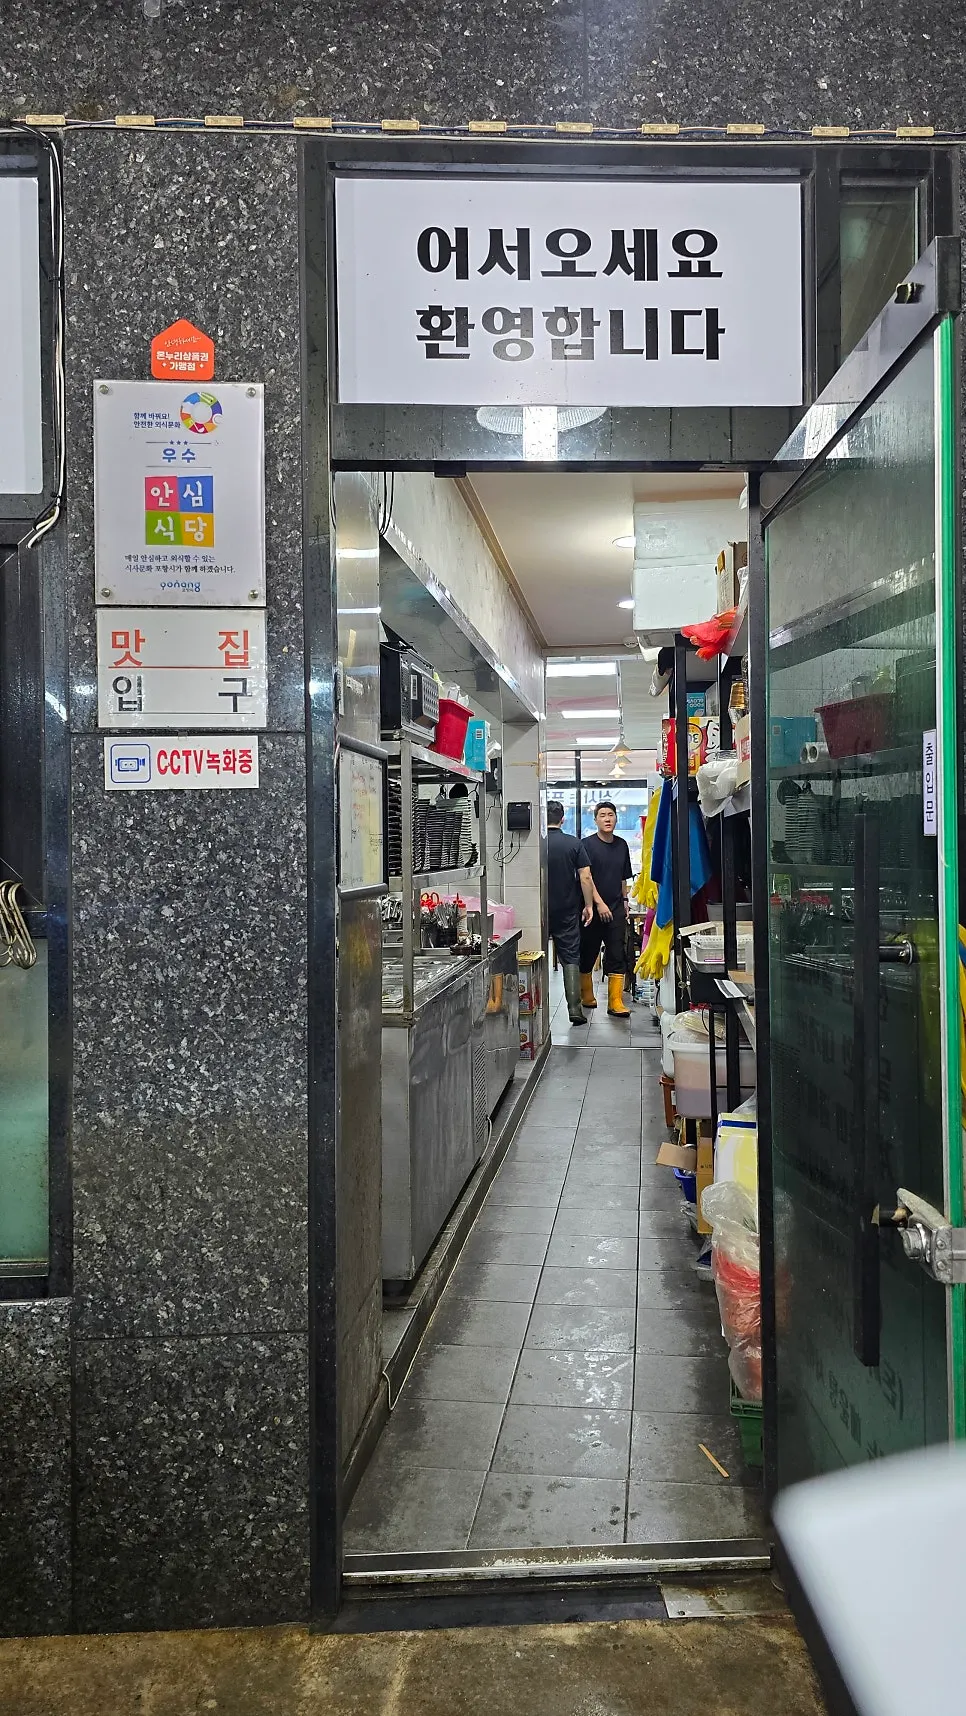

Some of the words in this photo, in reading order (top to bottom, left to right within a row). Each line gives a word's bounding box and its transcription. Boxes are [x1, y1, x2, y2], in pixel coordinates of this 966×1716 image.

[415, 225, 724, 282] 어서오세요
[414, 304, 726, 363] 환영합니다
[156, 350, 209, 362] 온누리상품권
[169, 361, 196, 371] 가맹점
[133, 412, 147, 420] 함께
[133, 421, 153, 429] 안전한
[154, 421, 181, 429] 외식문화
[162, 448, 196, 463] 우수
[150, 480, 204, 507] 안심
[154, 516, 208, 542] 식당
[156, 748, 253, 776] CCTV녹화중
[925, 742, 934, 822] 출입문
